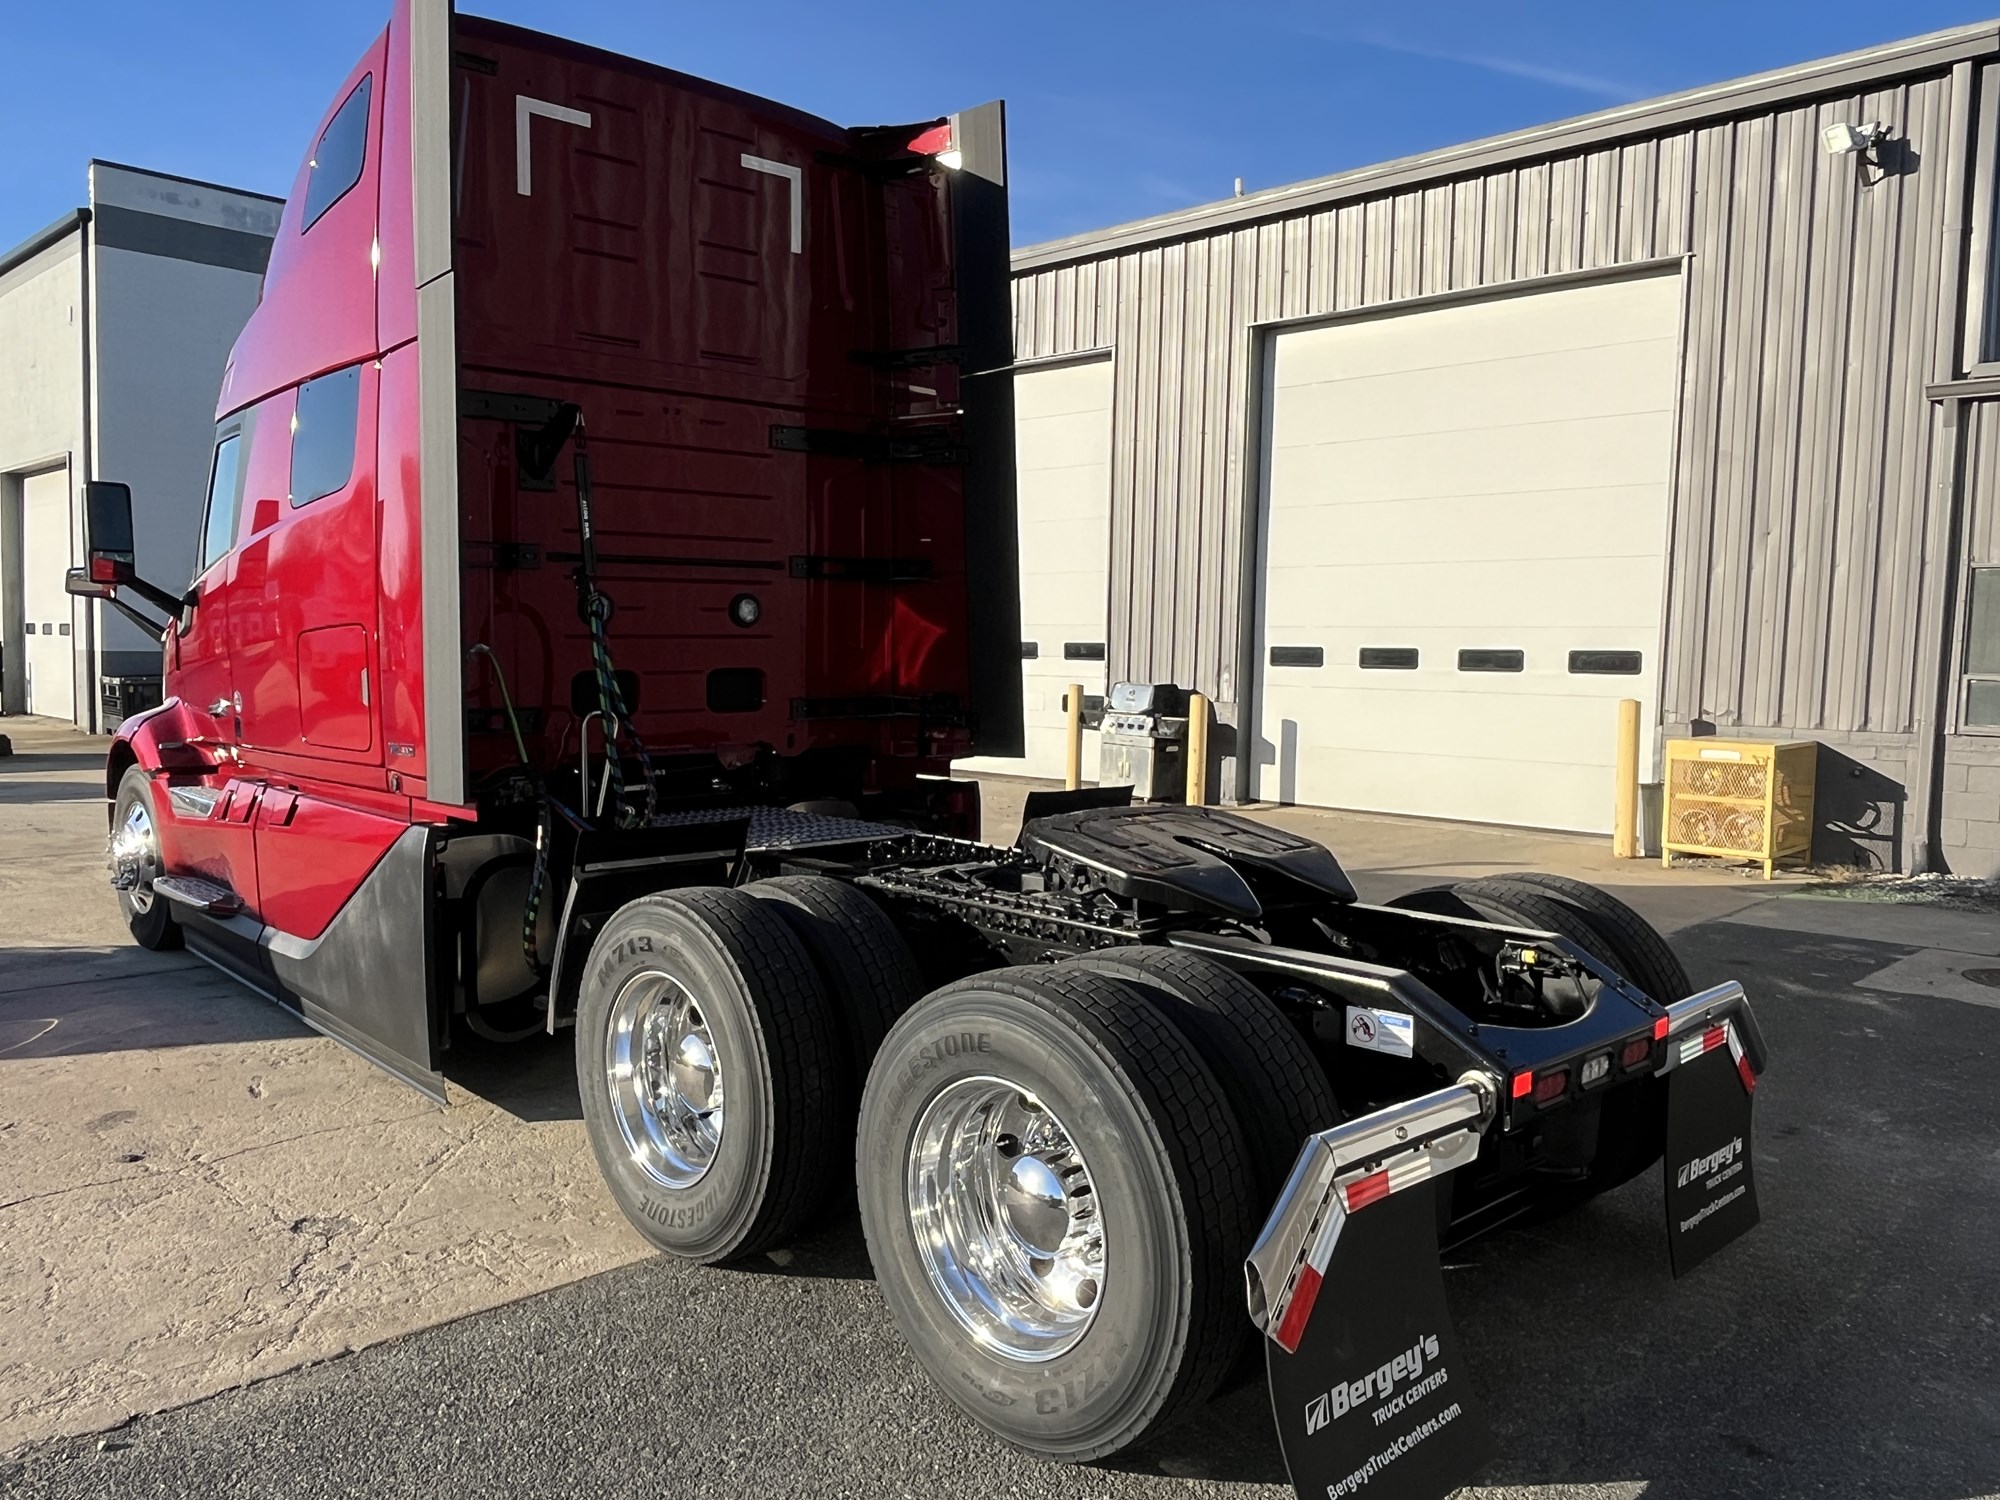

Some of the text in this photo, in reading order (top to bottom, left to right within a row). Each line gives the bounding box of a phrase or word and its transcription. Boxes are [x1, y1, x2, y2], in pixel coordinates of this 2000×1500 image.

[597, 936, 654, 988] M713
[1690, 1136, 1742, 1181] Bergey's
[1331, 1334, 1439, 1420] Bergey's
[1371, 1367, 1448, 1427] TRUCK CENTERS
[1326, 1402, 1462, 1500] BergeysTruckCenters.com
